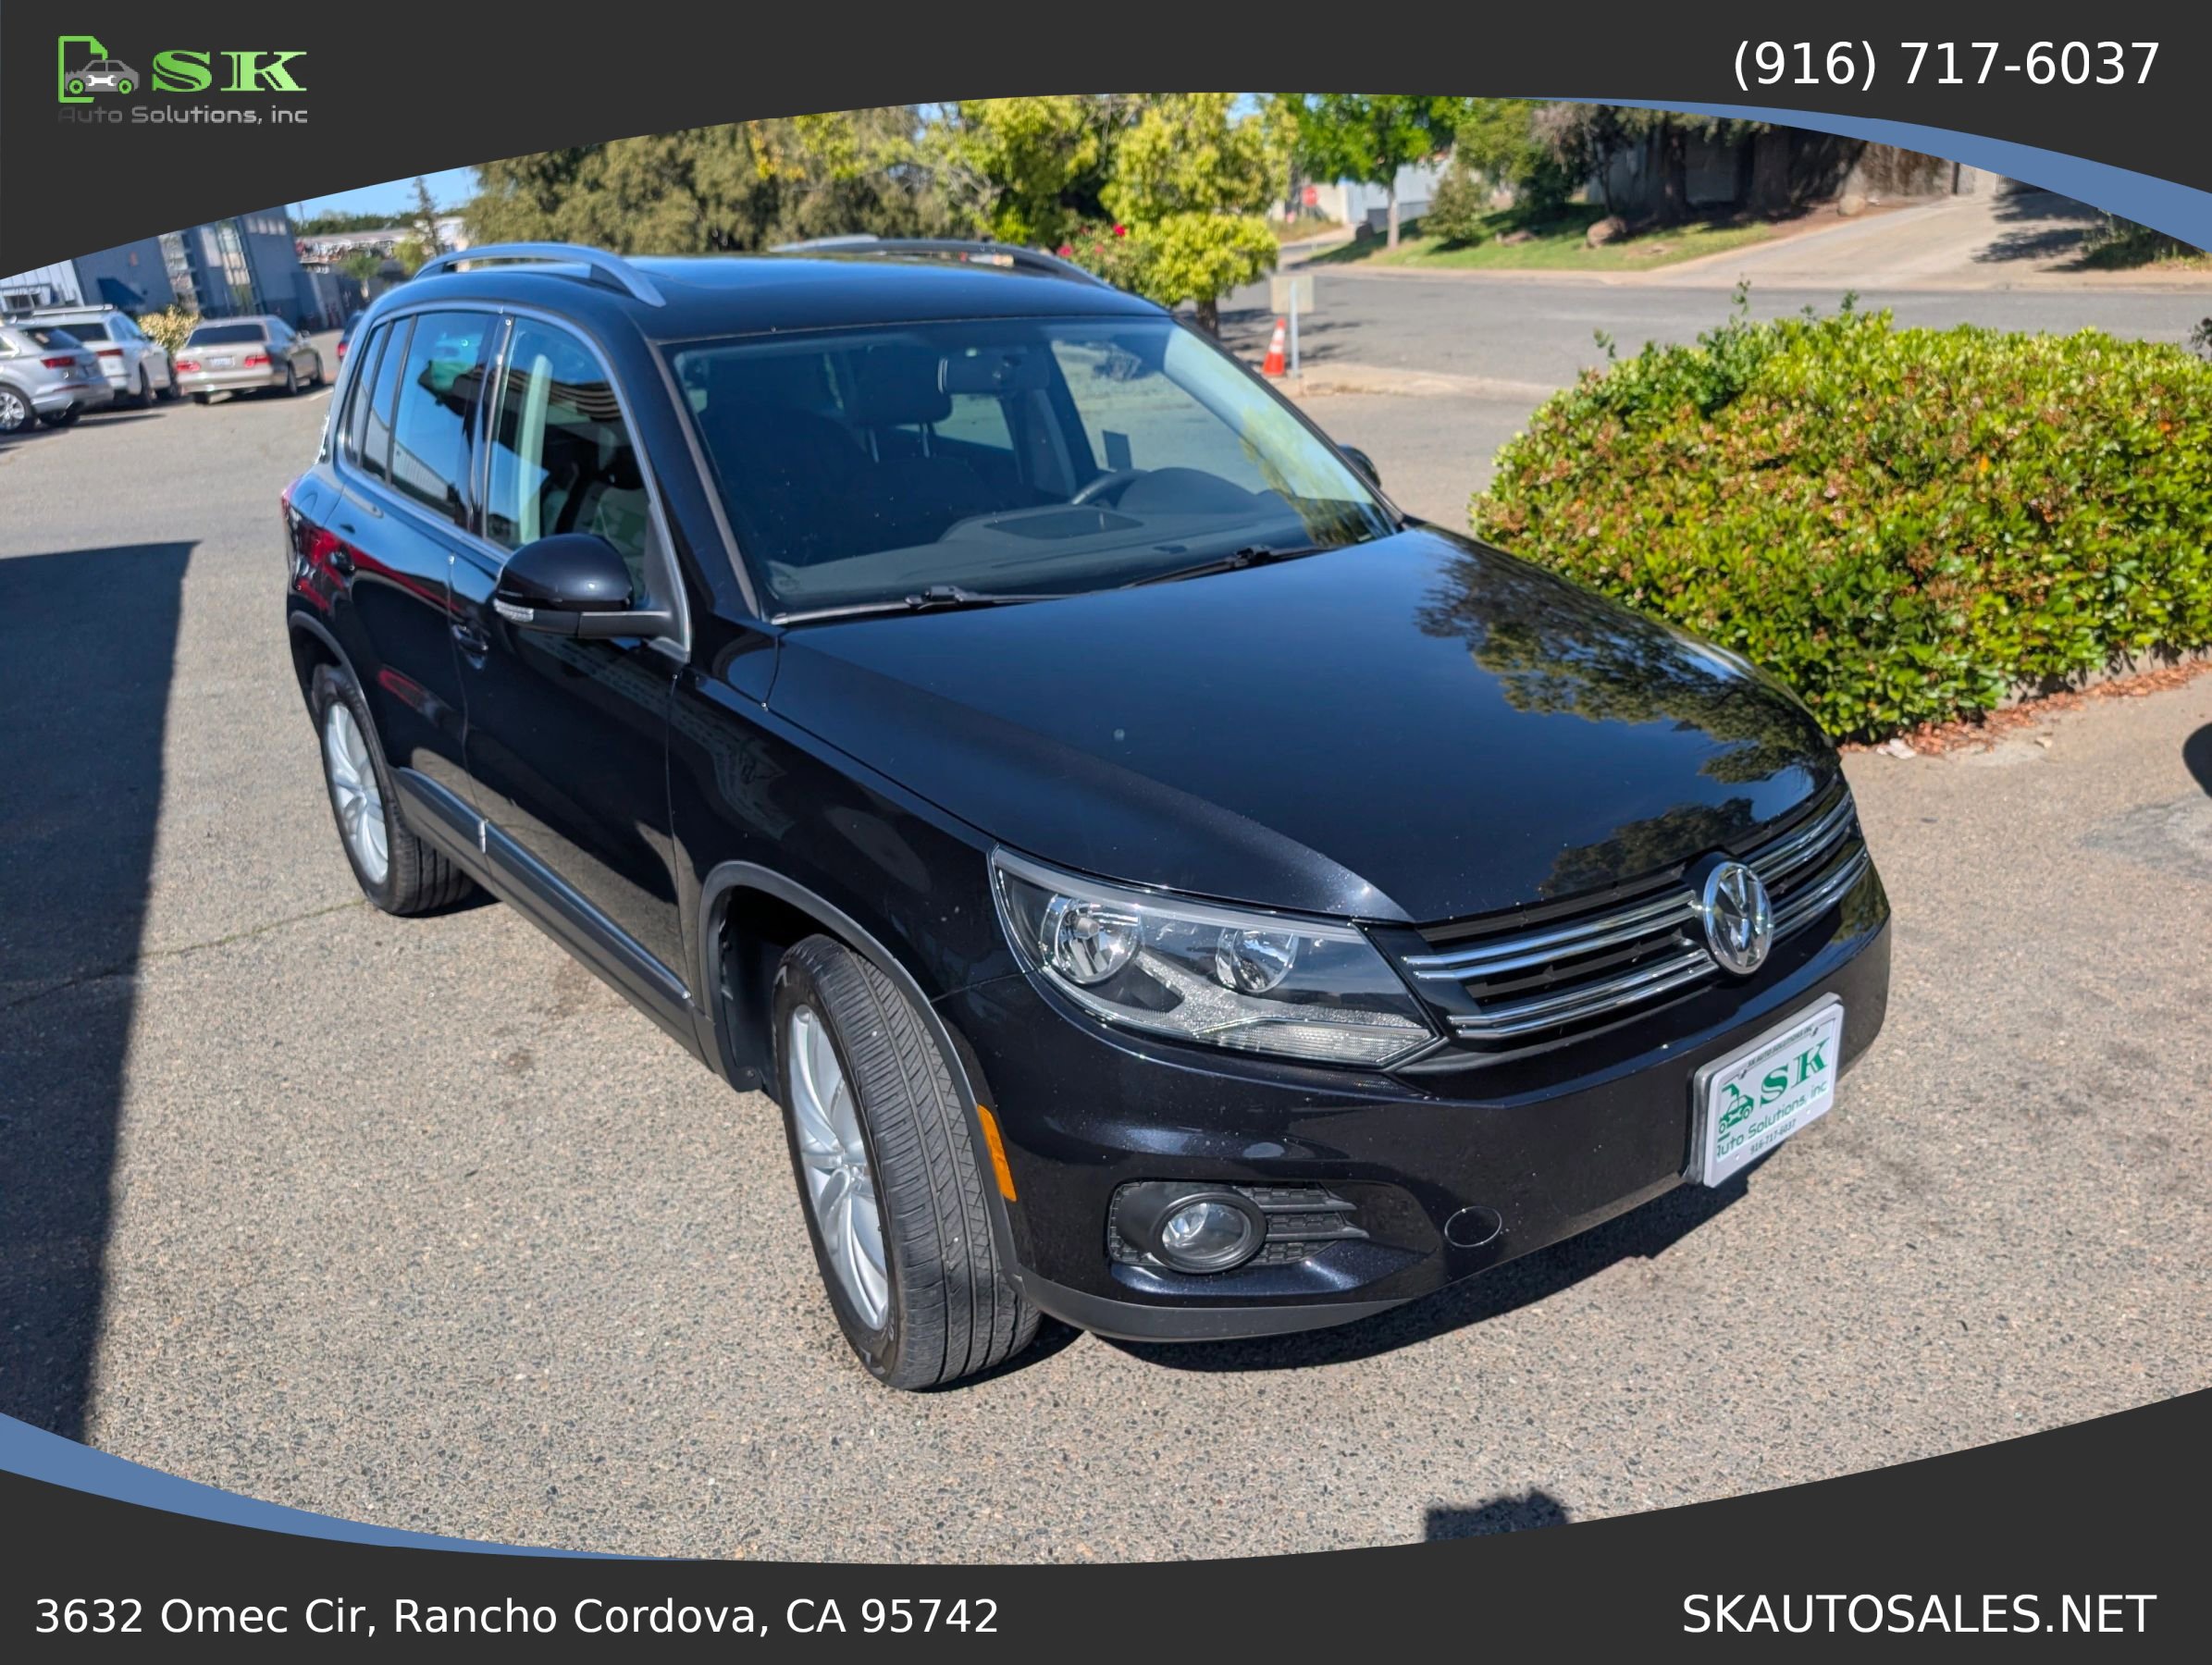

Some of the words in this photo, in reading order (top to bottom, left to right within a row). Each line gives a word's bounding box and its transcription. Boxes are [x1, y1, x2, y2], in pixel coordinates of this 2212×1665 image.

[1760, 1037, 1830, 1108] SK
[1810, 1079, 1828, 1098] inc
[1750, 1117, 1798, 1155] 916-717-6037
